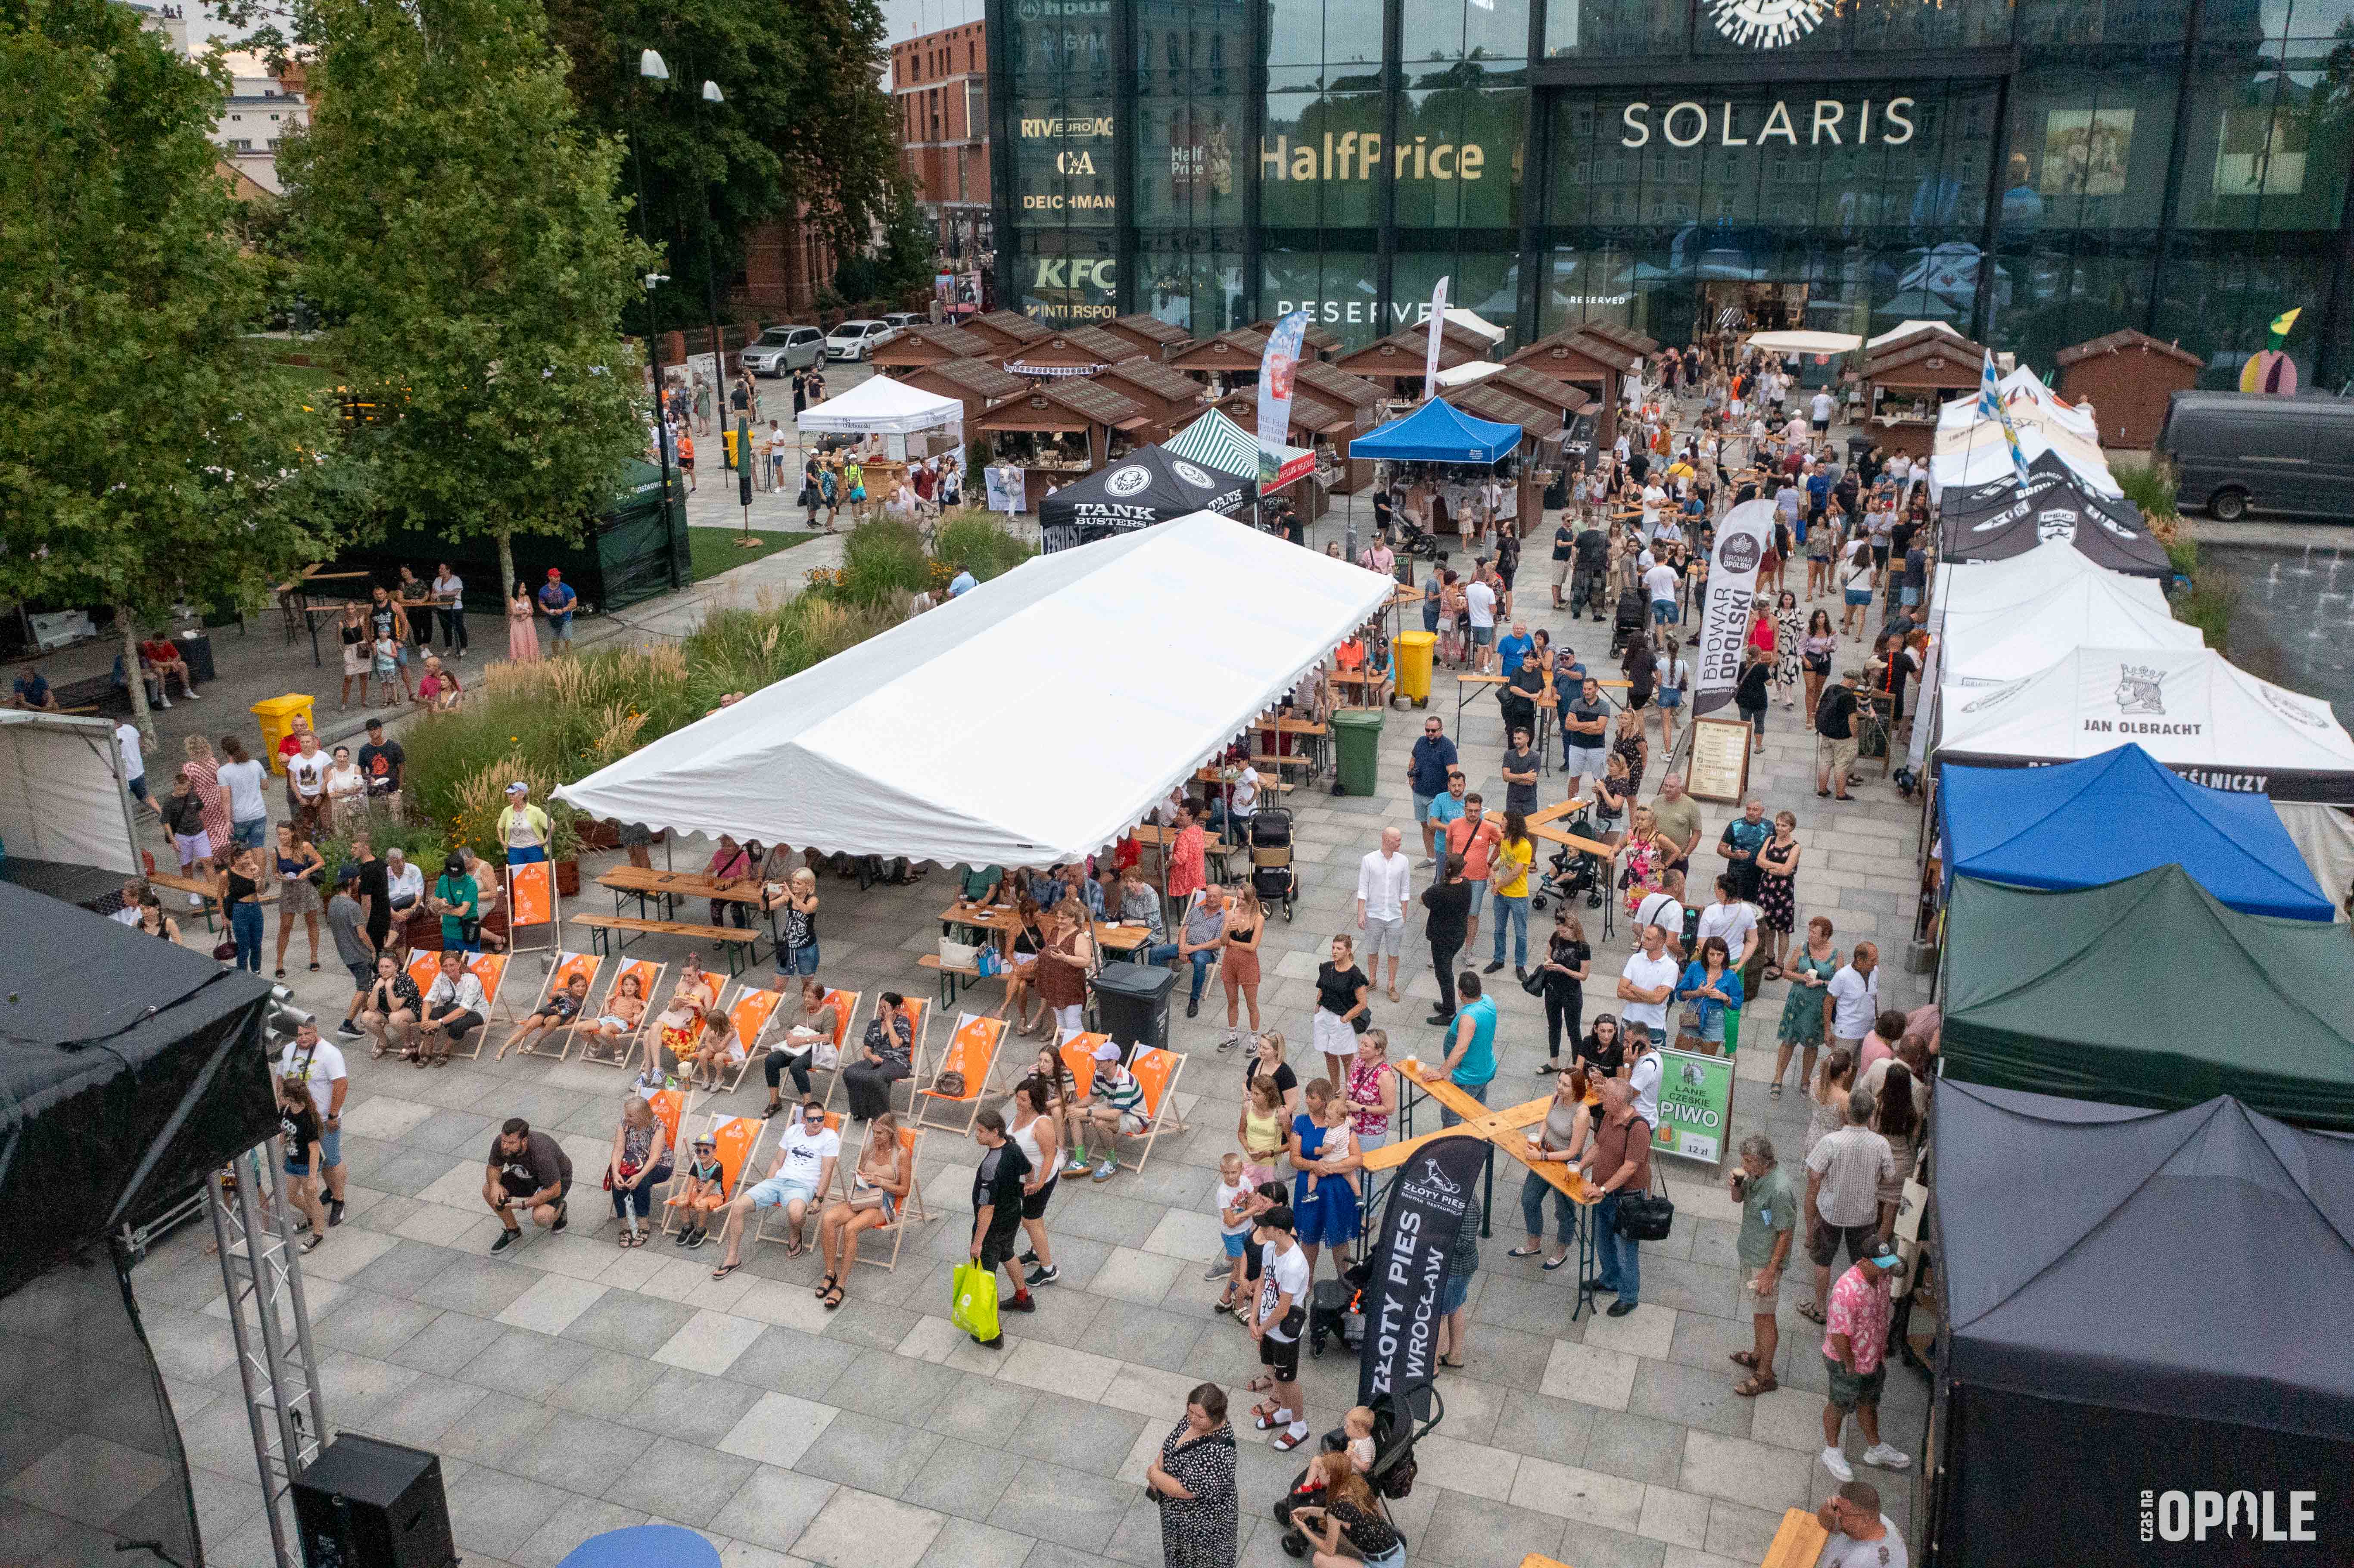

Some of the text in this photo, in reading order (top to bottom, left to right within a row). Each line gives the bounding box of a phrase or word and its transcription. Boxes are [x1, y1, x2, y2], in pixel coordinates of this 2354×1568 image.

[1021, 118, 1053, 138] RTV
[1093, 117, 1114, 137] AG
[1622, 97, 1915, 148] SOLARIS
[1057, 151, 1096, 174] C&A
[1171, 145, 1203, 161] Half
[1261, 131, 1484, 181] HalfPrice
[1023, 195, 1115, 209] DEICHMAN
[1033, 258, 1117, 289] KFC
[1570, 296, 1625, 305] RESERVED
[1041, 305, 1117, 318] INTRSPO
[1208, 489, 1242, 513] TANK
[1217, 502, 1241, 516] STERS
[1074, 503, 1155, 521] TANK
[1074, 517, 1147, 529] BUSTERS
[1723, 560, 1751, 569] OPOLSKI
[1724, 554, 1753, 564] BROWAR
[1703, 588, 1731, 681] BROWAR
[1719, 589, 1752, 679] OPOLSKI
[2083, 719, 2202, 735] JAN OLBRACHT
[1669, 1092, 1710, 1107] CZESKIE
[1675, 1085, 1706, 1096] LANE
[1659, 1099, 1720, 1128] PIWO
[1688, 1145, 1699, 1154] 12
[1401, 1192, 1463, 1216] BROWAR RESTAURACJA
[1402, 1181, 1466, 1209] ZŁOTY PIES
[1371, 1209, 1421, 1394] ZŁOTY PIES
[1406, 1246, 1444, 1379] WROCŁAW
